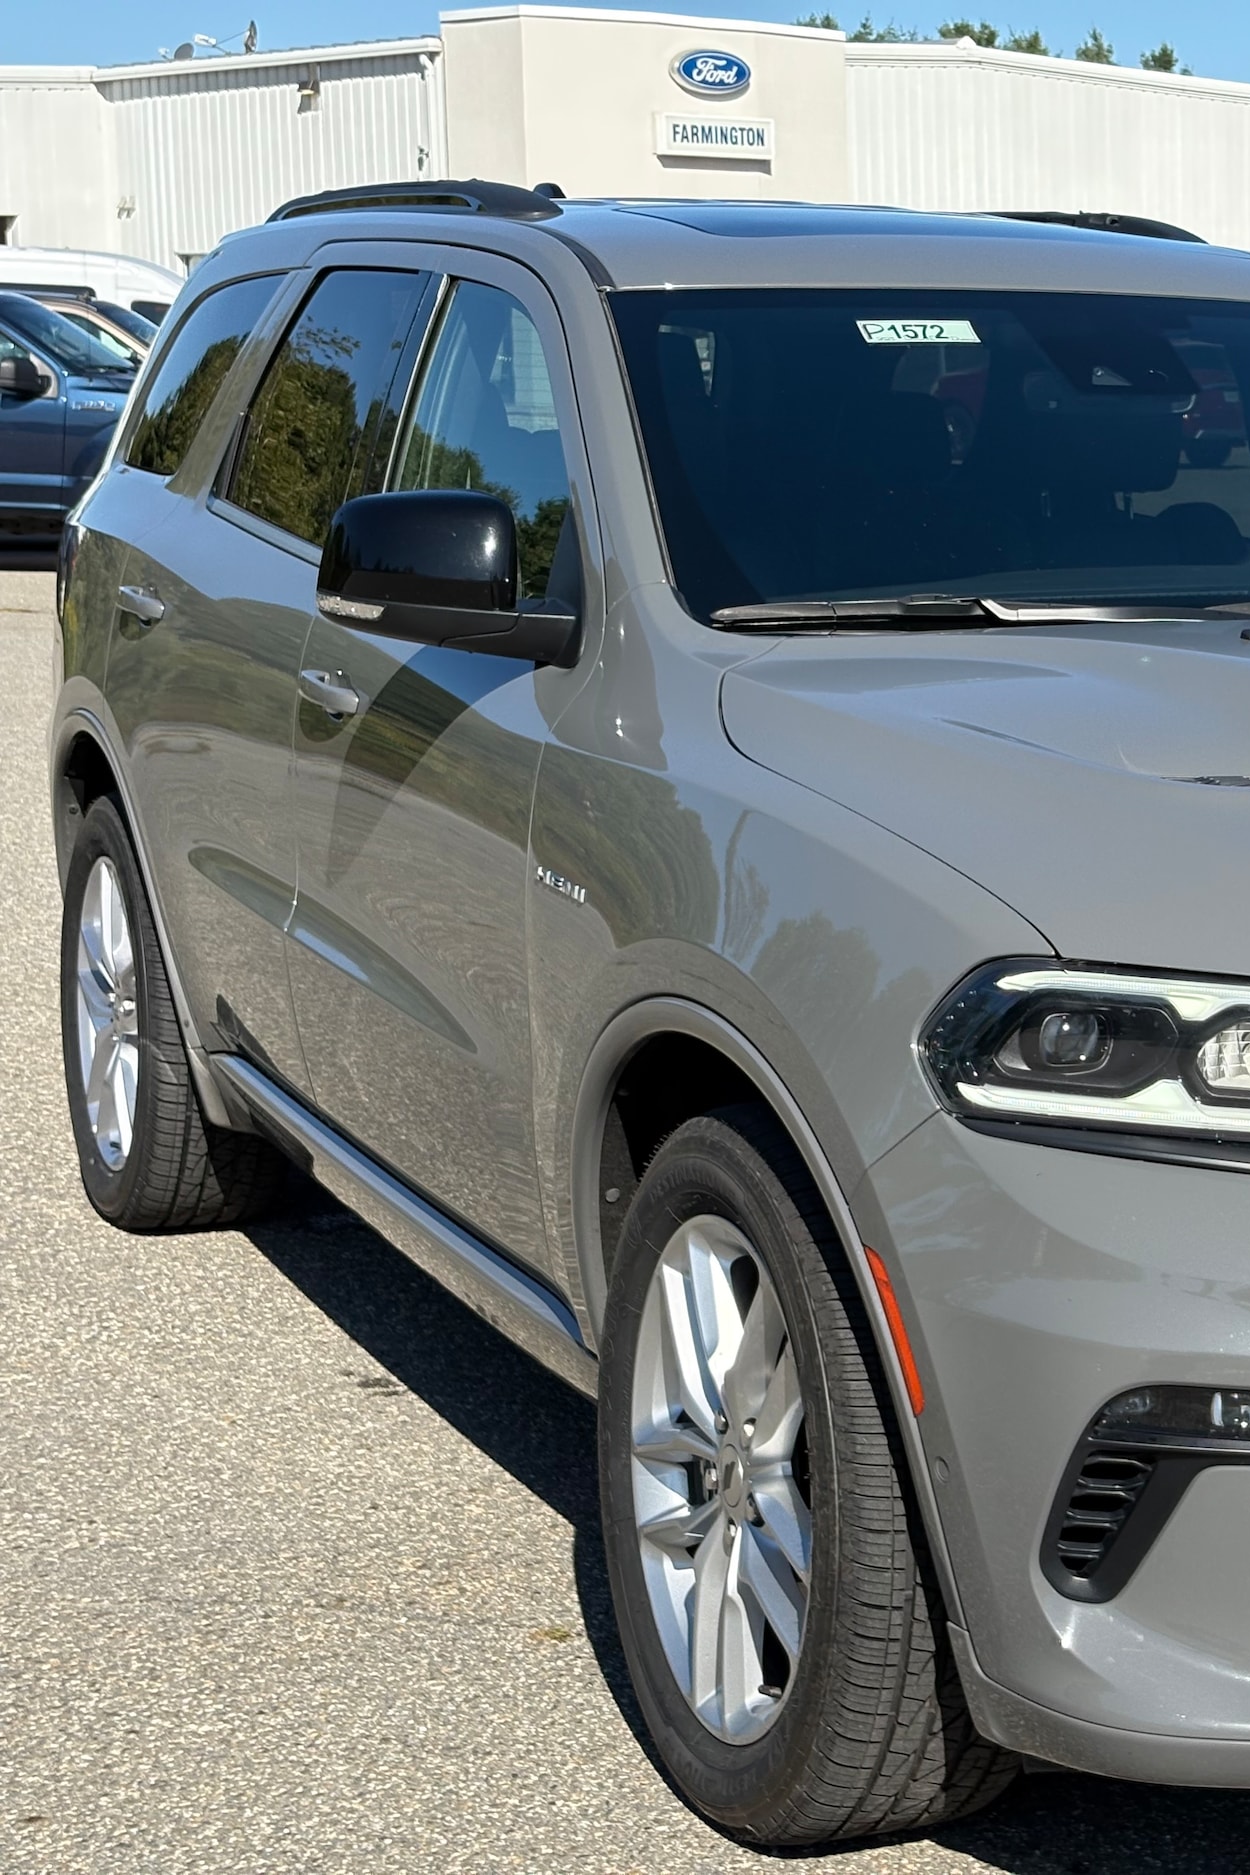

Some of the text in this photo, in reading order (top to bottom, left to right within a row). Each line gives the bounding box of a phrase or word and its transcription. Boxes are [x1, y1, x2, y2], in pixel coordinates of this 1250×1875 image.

[692, 57, 738, 84] Ford
[672, 123, 765, 147] FARMINGTON
[862, 323, 949, 340] P1572
[536, 866, 586, 903] HEMI
